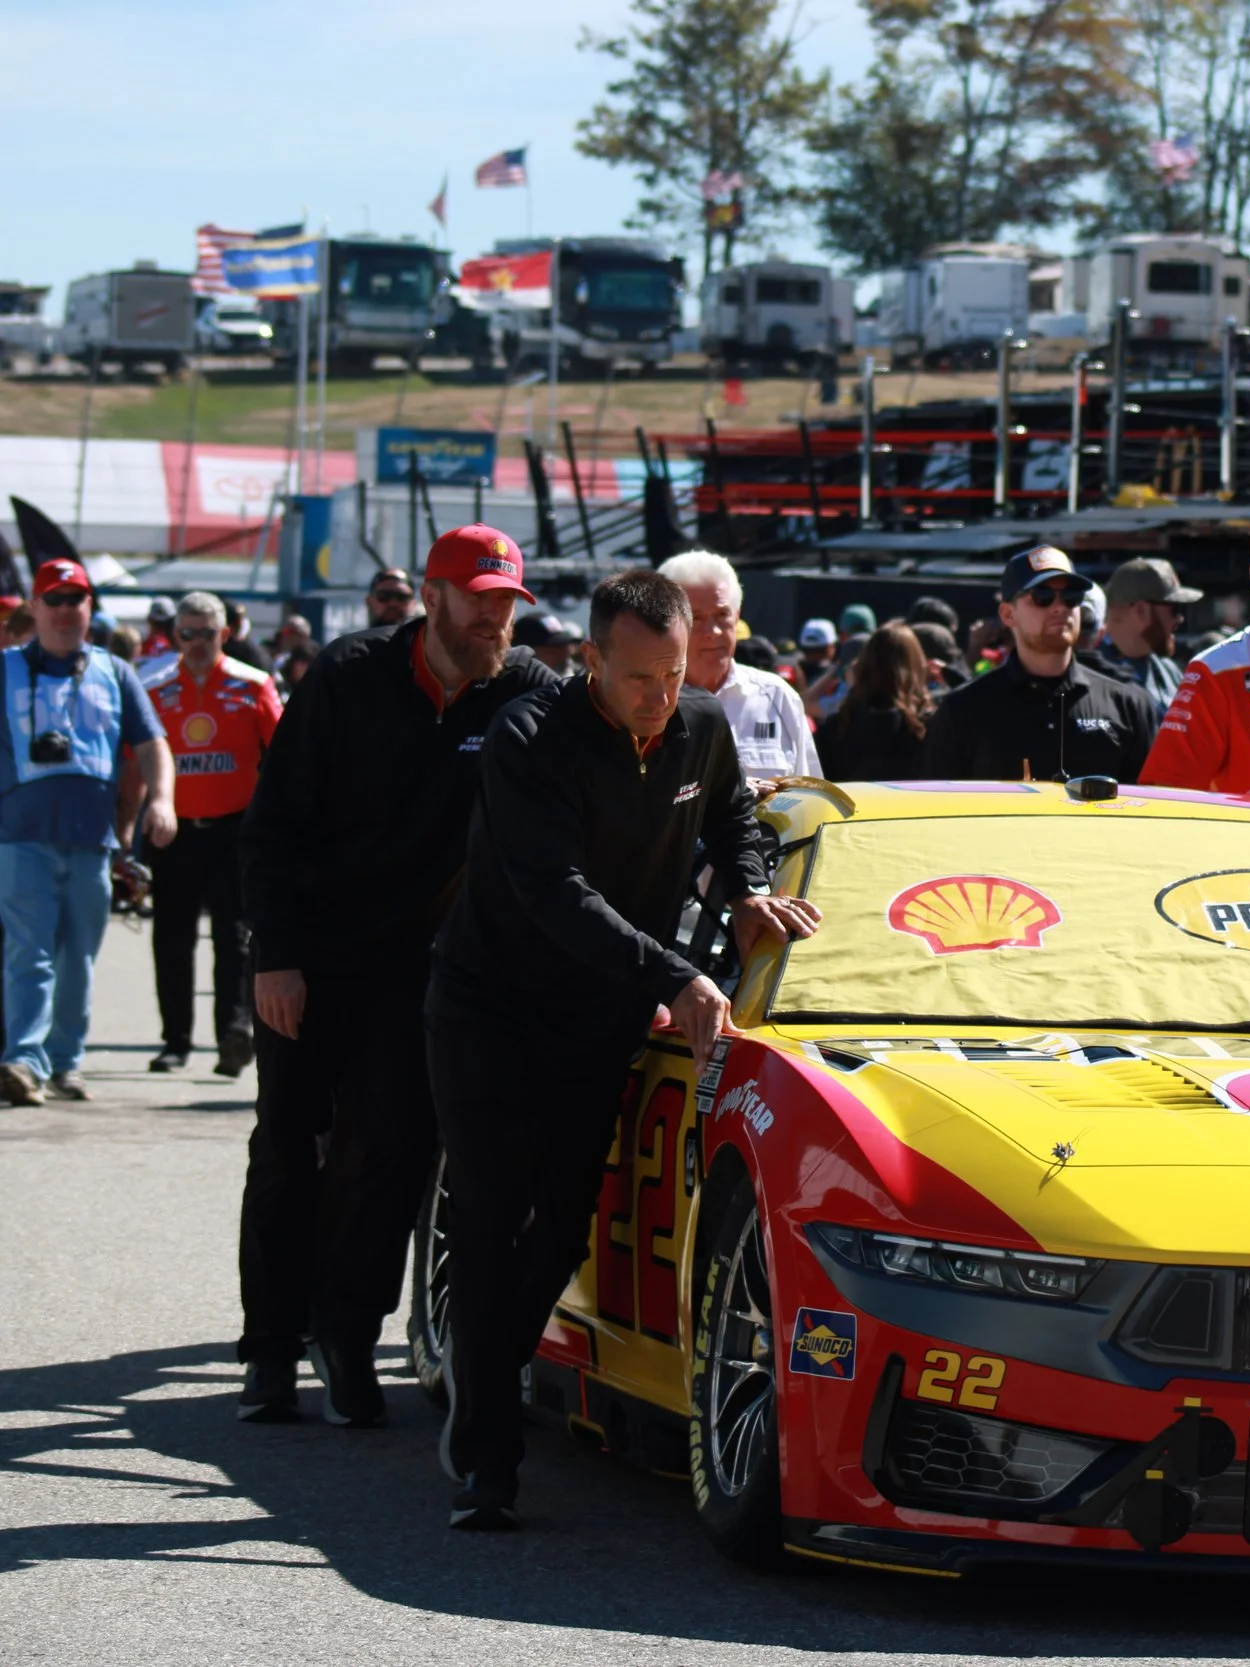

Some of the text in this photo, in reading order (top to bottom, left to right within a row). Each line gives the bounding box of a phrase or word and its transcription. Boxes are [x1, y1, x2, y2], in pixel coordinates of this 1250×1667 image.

[714, 1080, 775, 1137] GOODYEAR
[798, 1334, 853, 1358] SUNOCO
[917, 1348, 1007, 1411] 22
